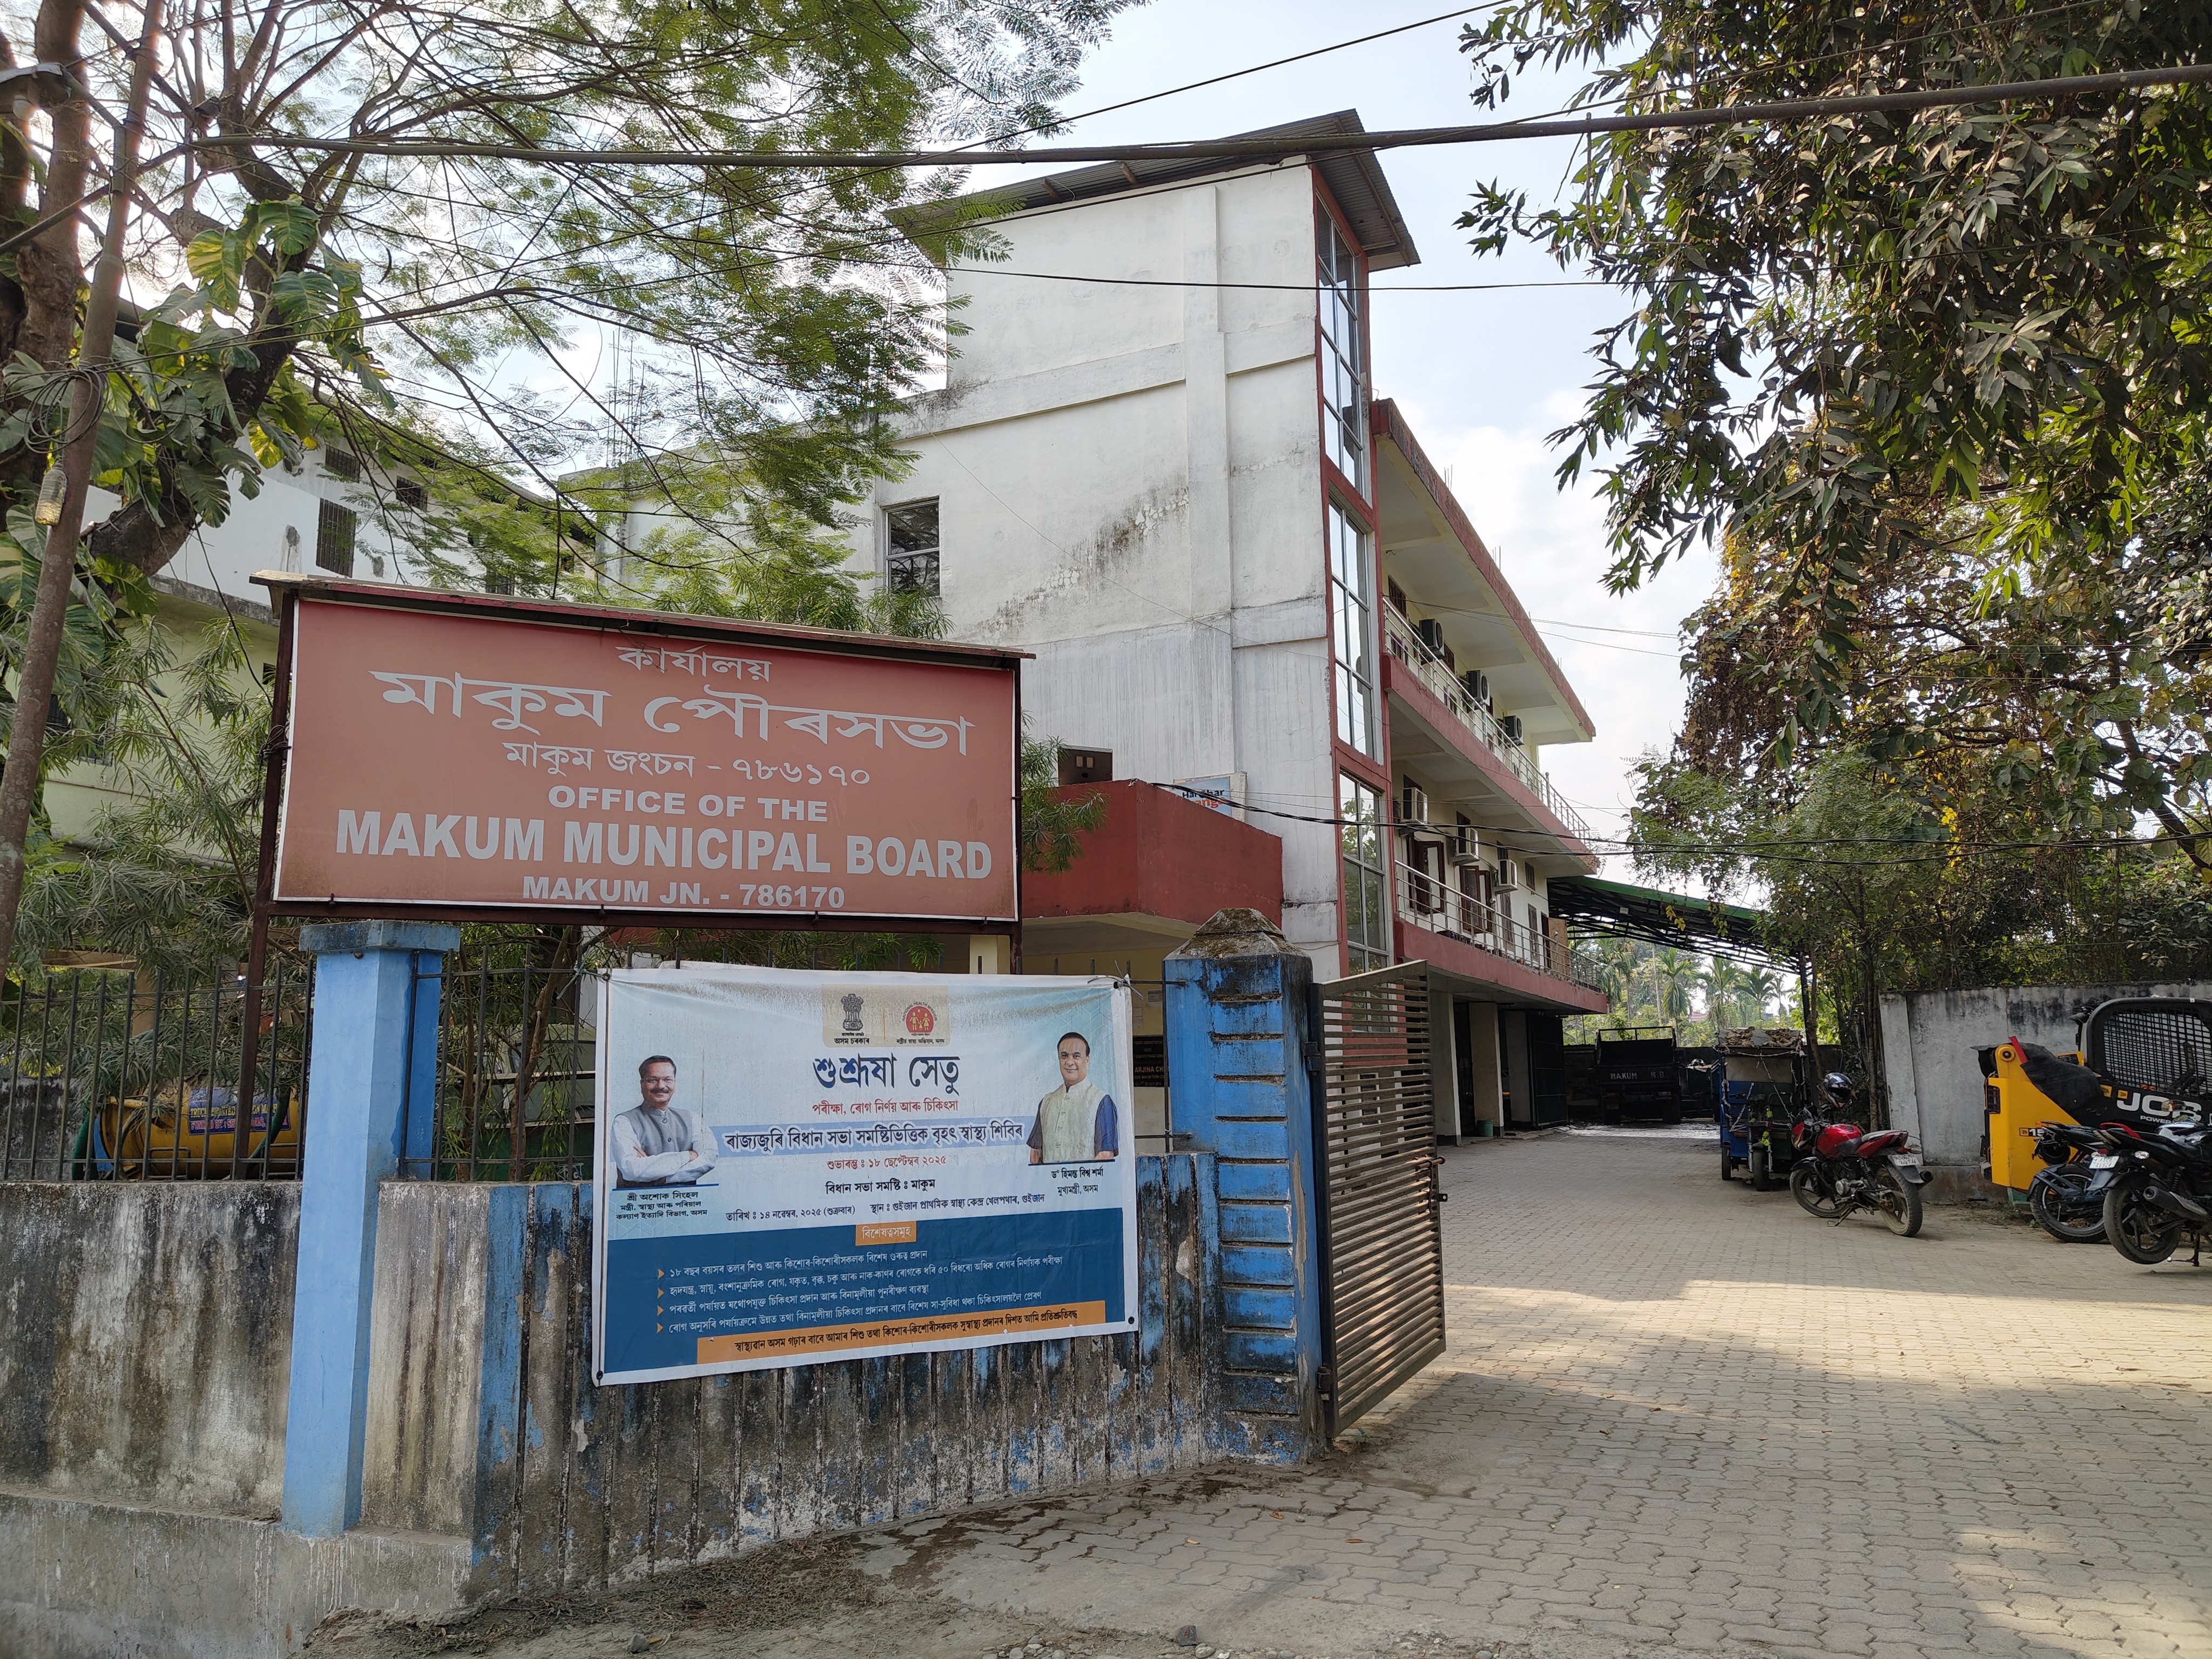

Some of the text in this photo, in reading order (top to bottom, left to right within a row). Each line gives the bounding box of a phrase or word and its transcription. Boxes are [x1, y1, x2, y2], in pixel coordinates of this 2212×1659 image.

[369, 670, 611, 736] মাকুম
[503, 741, 870, 785] মাকুম জংচন ৭৮৬১৭০
[548, 785, 827, 822] OFFICE OF THE
[336, 810, 992, 879] MAKUM MUNICIPAL BOARD
[522, 875, 845, 909] MAKUM JN. 786170
[902, 1003, 914, 1021] NATIONAL
[909, 1056, 960, 1096] সেতু
[1610, 1072, 1637, 1080] MAKUM
[851, 1102, 872, 1115] ৰোগ
[900, 1102, 921, 1113] আৰু
[923, 1097, 958, 1112] চিকিৎসা
[2116, 1092, 2202, 1122] JCB
[2140, 1115, 2171, 1124] POWER
[787, 1127, 822, 1147] বিধান
[826, 1129, 852, 1145] সভা
[856, 1123, 928, 1143] সমষ্টিভিত্তিক
[932, 1127, 957, 1145] বৃহৎ
[959, 1124, 987, 1143] স্বাস্থ্য
[990, 1120, 1022, 1139] শিবিৰ
[869, 1158, 880, 1168] ১৮
[922, 1156, 946, 1165] ২০২৫
[1061, 1167, 1078, 1179] হিমন্ত
[1079, 1166, 1090, 1178] বিশ্ব
[672, 1191, 699, 1199] সিংহল
[825, 1178, 935, 1195] বিধান সভা সমষ্টি মাকুম
[1083, 1185, 1098, 1193] অসম
[870, 1203, 884, 1215] স্থান
[893, 1201, 917, 1212] গুইজান
[1022, 1193, 1045, 1203] গুইজান
[861, 1226, 912, 1239] বিশেষত্বসমূহ
[670, 1269, 682, 1278] ১৮
[747, 1260, 763, 1272] শিশু
[866, 1252, 888, 1263] বিশেষ
[827, 1274, 838, 1285] চকু
[974, 1259, 994, 1271] অধিক
[759, 1314, 777, 1324] উন্নত
[779, 1313, 794, 1323] তথা
[835, 1305, 863, 1318] চিকিৎসা
[890, 1304, 906, 1312] বাবে
[908, 1300, 928, 1311] বিশেষ
[962, 1297, 975, 1306] থকা
[768, 1294, 797, 1306] চিকিৎসা
[767, 1338, 785, 1347] অসম
[808, 1334, 824, 1344] বাবে
[850, 1328, 865, 1341] শিশু
[867, 1328, 880, 1338] তথা
[1005, 1314, 1022, 1326] দিশত
[1024, 1311, 1039, 1323] আমি
